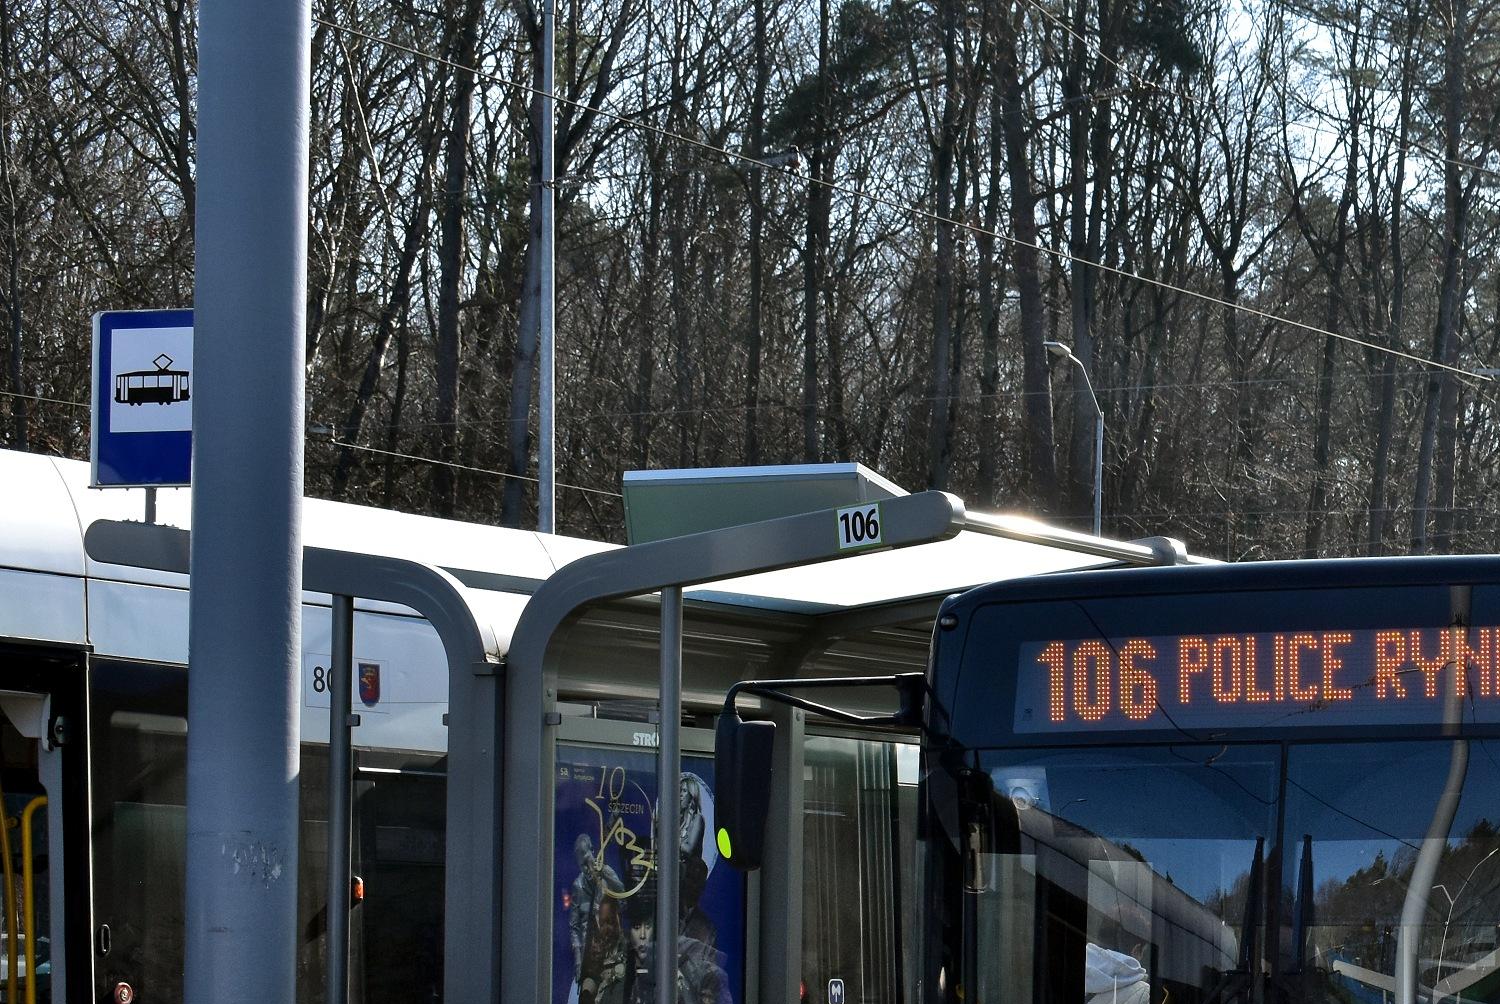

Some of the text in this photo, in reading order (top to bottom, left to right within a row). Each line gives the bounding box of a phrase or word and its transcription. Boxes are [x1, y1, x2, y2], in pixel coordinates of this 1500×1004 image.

[840, 508, 879, 543] 106
[1036, 639, 1157, 721] 106
[1180, 633, 1352, 704] POLICE
